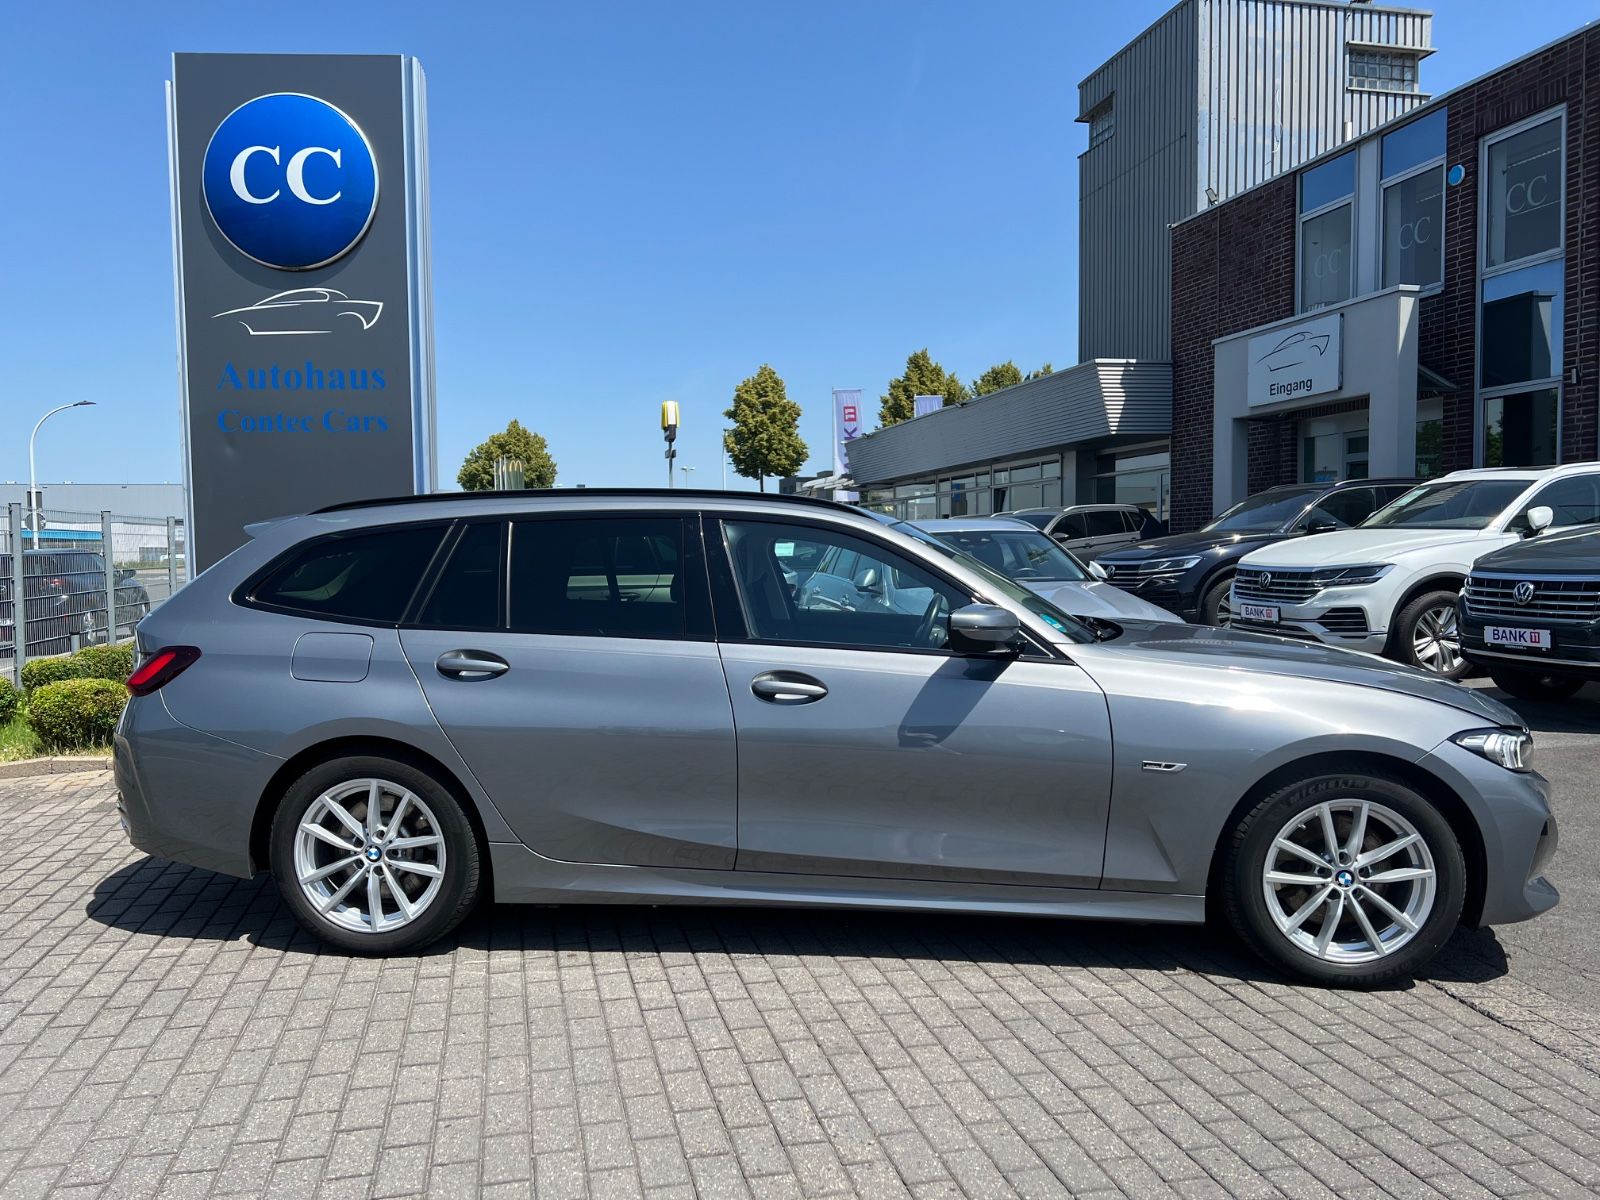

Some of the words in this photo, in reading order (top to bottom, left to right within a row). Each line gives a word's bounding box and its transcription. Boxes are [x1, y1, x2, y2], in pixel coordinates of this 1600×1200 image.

[229, 145, 342, 205] CC
[1506, 174, 1548, 213] CC
[1399, 216, 1431, 250] CC
[216, 360, 387, 391] Autohaus
[1269, 376, 1313, 396] Eingang
[217, 408, 314, 433] Contec
[322, 408, 389, 433] Cars
[1245, 606, 1265, 618] BANK
[1492, 628, 1528, 643] BANK
[1530, 631, 1540, 643] 11
